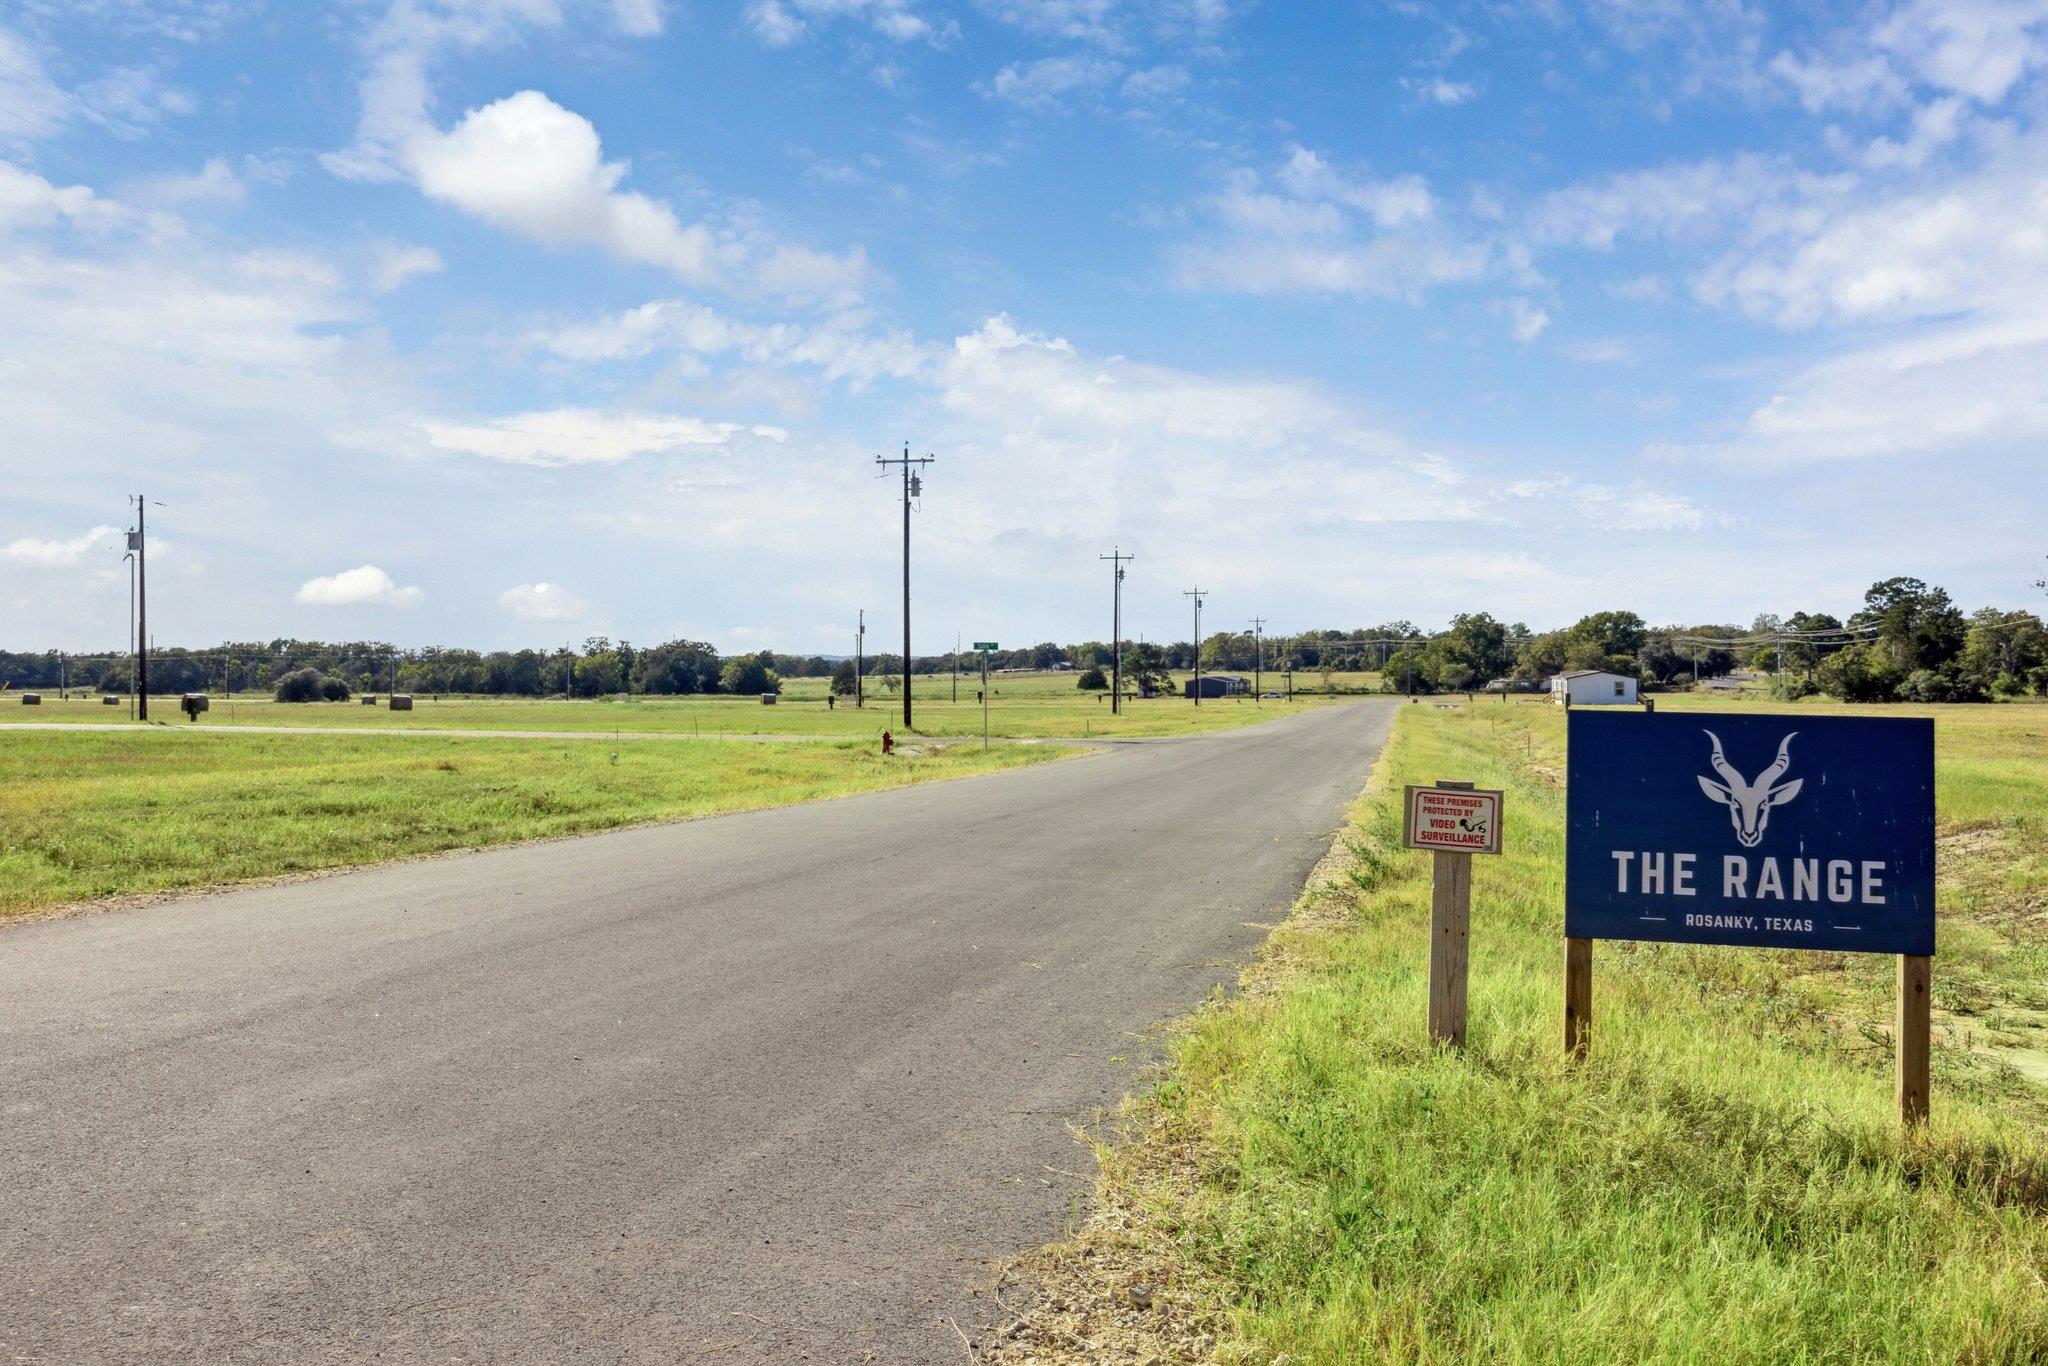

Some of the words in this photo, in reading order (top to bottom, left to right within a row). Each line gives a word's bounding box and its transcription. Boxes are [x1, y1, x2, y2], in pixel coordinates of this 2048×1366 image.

[1423, 796, 1445, 805] THESE
[1447, 798, 1483, 808] PREMISES
[1422, 806, 1462, 816] PROTECTED
[1464, 809, 1474, 817] BY
[1430, 819, 1456, 829] VIDEO
[1421, 831, 1486, 844] SURVEILLANCE
[1611, 850, 1697, 896] THE
[1723, 855, 1886, 905] RANGE
[1686, 913, 1758, 931] ROSANKY,
[1764, 917, 1813, 932] TEXAS
